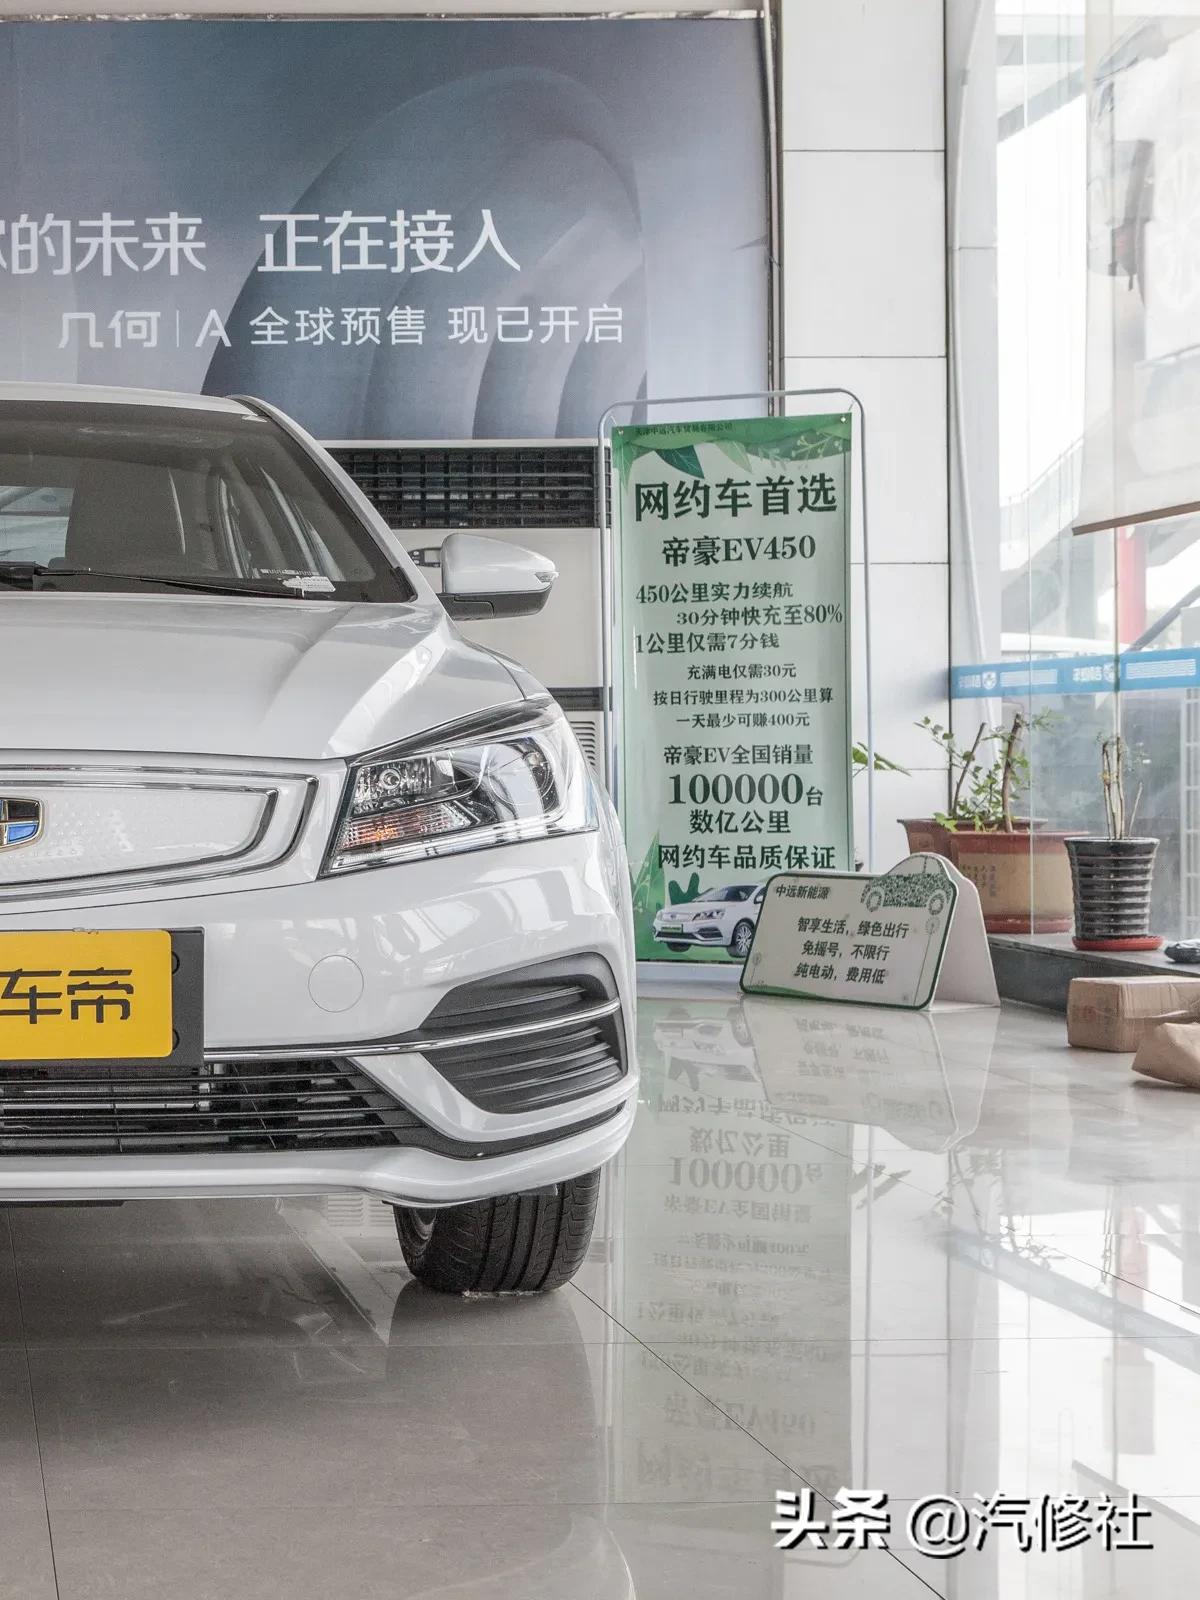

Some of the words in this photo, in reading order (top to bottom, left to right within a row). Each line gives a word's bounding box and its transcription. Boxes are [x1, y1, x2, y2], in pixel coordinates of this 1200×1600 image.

[257, 209, 521, 275] 正在接入
[58, 310, 161, 349] 几何
[194, 309, 232, 348] A
[248, 306, 428, 346] 全球预售
[447, 304, 624, 345] 现已开启
[635, 472, 838, 522] 网约车首选
[661, 534, 817, 567] 帝豪EV450
[635, 581, 794, 605] 450公里实力续航
[676, 603, 844, 627] 30分钟快充至80%
[635, 632, 780, 655] 1公里仅需7分钱
[687, 663, 797, 680] 充满电仅需30元
[652, 687, 834, 706] 按日行驶里程为300公里算
[676, 712, 811, 729] 一天最少可赚400元
[663, 744, 814, 766] 帝豪EV全国销量
[667, 772, 824, 808] 100000台
[689, 808, 791, 835] 数亿公里
[658, 844, 836, 871] 网约车品质保证
[775, 884, 831, 900] 中远新能源
